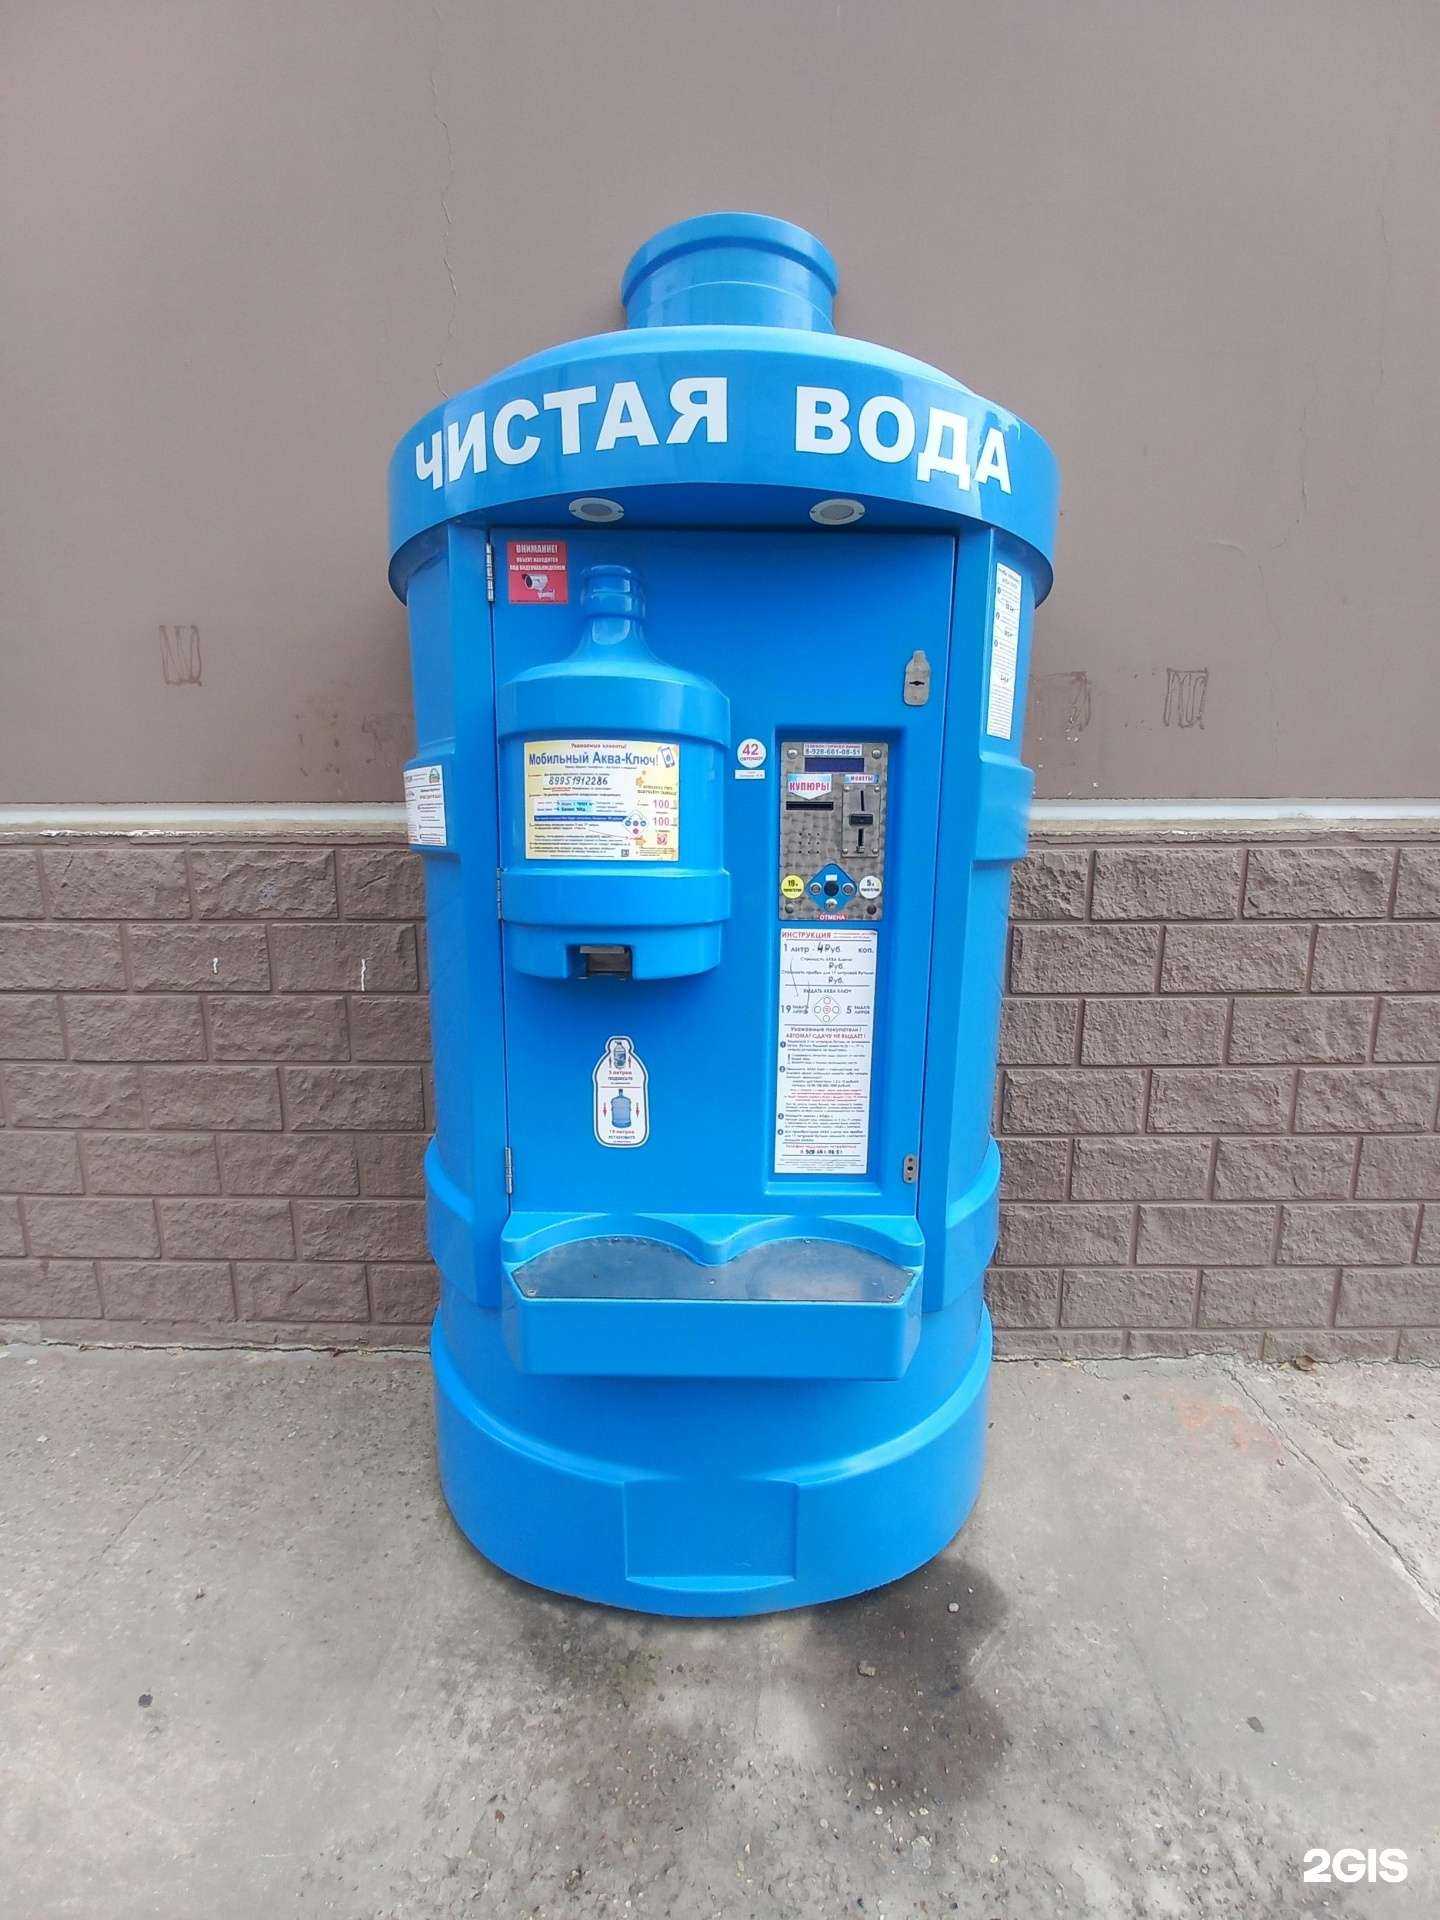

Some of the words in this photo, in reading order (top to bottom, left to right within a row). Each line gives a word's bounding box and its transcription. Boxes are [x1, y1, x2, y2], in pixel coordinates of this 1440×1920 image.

[415, 376, 728, 491] ЧИСТАЯ
[795, 385, 1012, 493] ВОДА
[516, 544, 558, 554] ВНИМАНИЕ!
[743, 743, 759, 756] 42
[529, 752, 589, 766] Мобильный
[593, 752, 659, 766] Аква-Ключ!
[789, 781, 830, 791] КУПЮРЫ
[653, 800, 670, 809] 100
[653, 817, 670, 826] 100
[782, 931, 832, 939] ИНСТРУКЦИЯ
[781, 1005, 791, 1014] 19
[846, 1005, 852, 1014] 5
